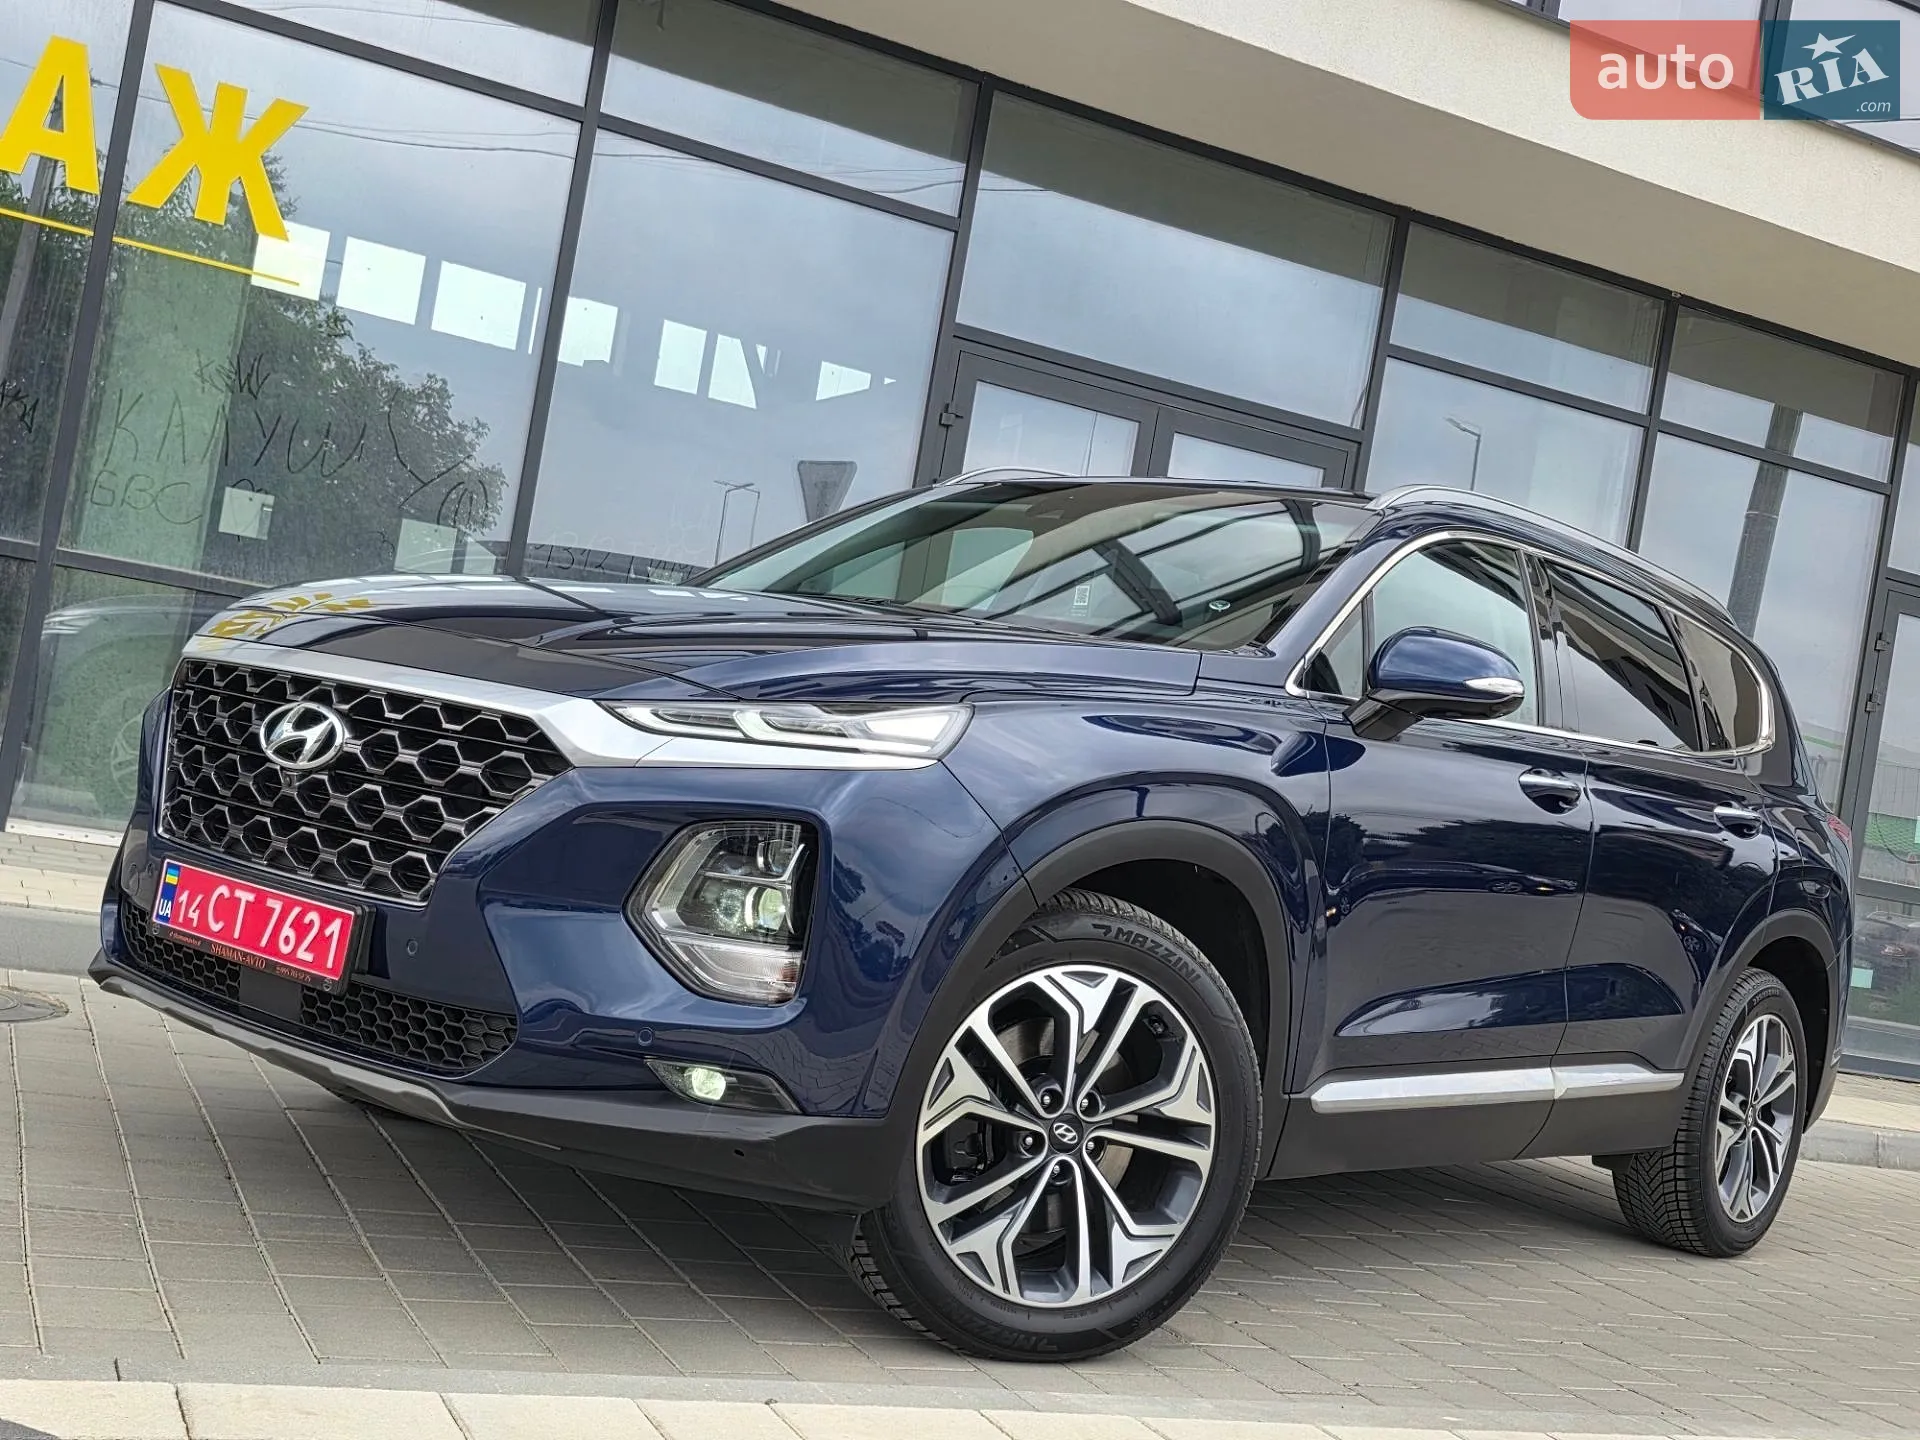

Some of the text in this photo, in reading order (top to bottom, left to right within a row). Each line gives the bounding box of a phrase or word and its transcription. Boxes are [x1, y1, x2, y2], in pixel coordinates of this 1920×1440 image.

[158, 898, 172, 918] UA
[259, 899, 344, 969] 7621
[1113, 926, 1202, 984] MAZZINI
